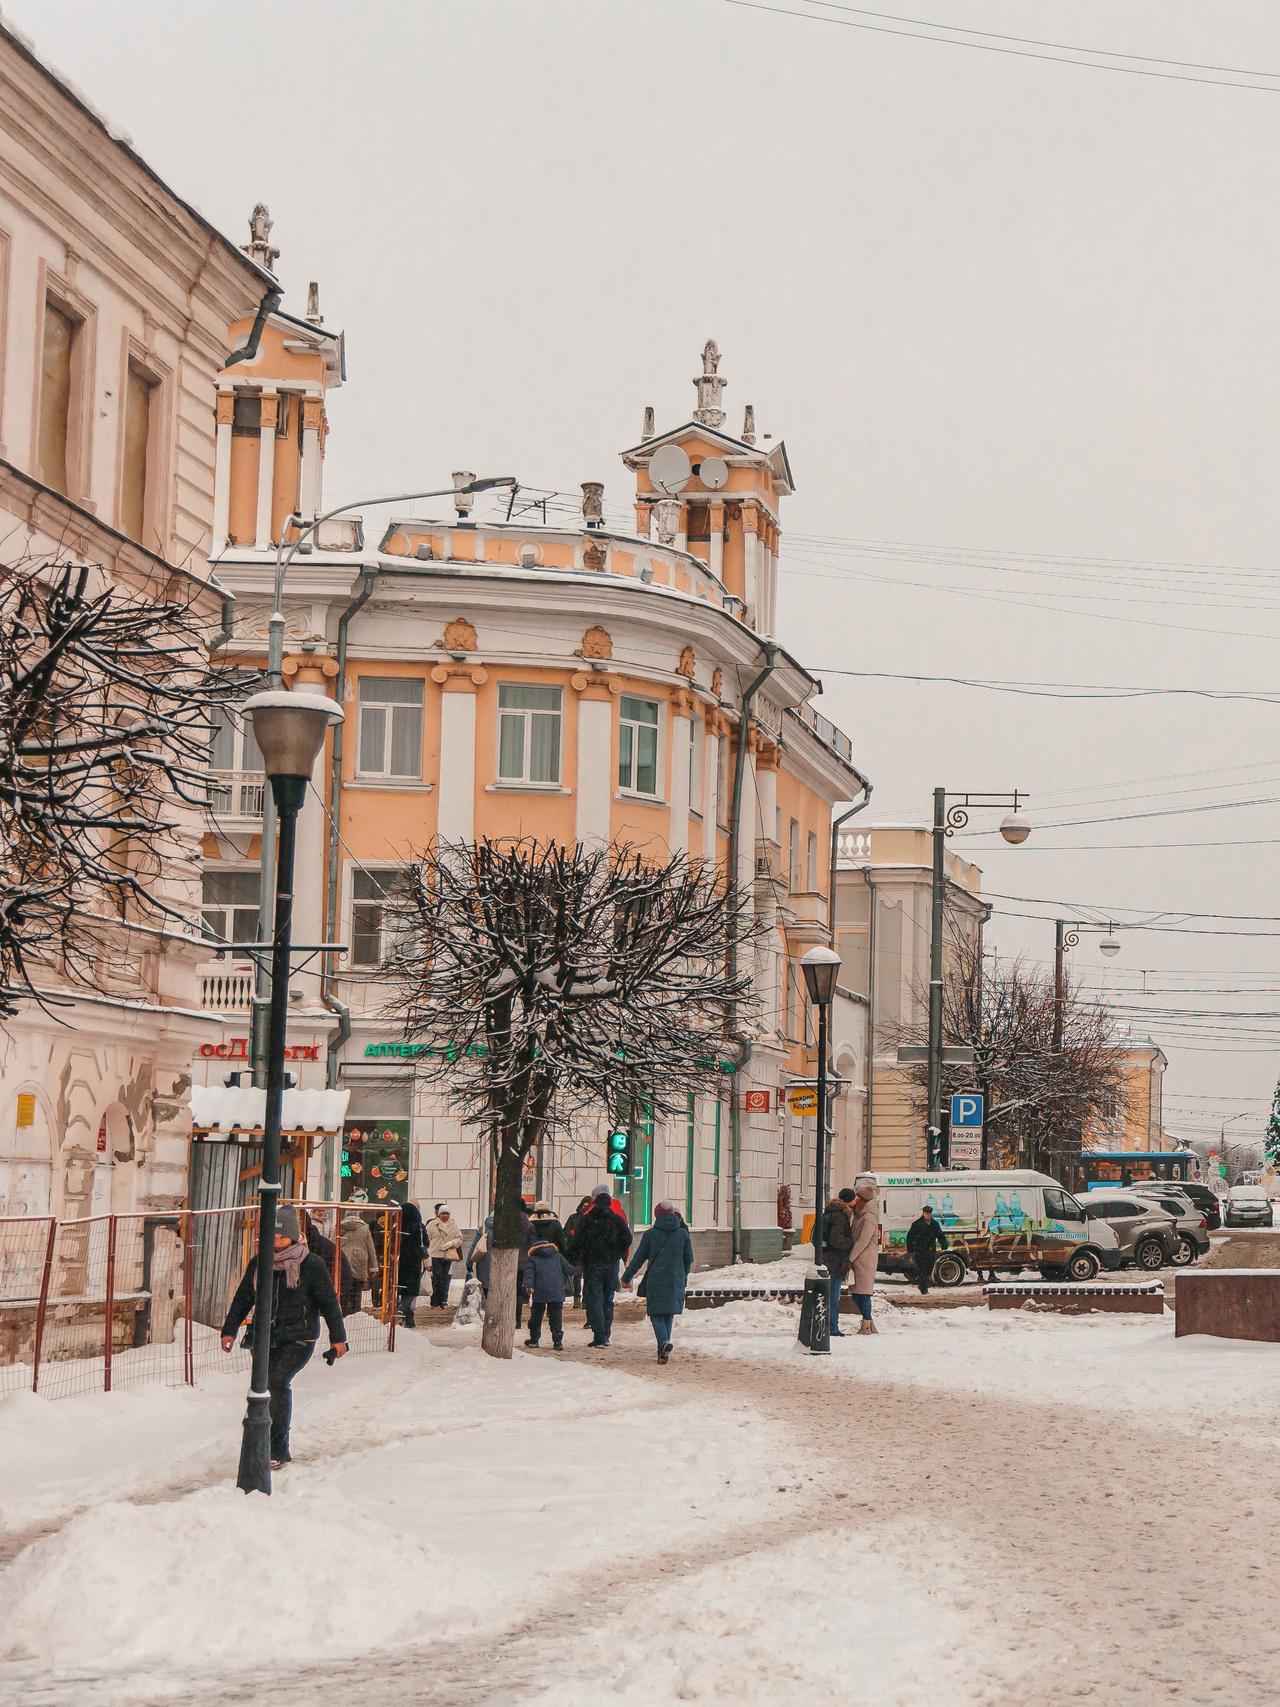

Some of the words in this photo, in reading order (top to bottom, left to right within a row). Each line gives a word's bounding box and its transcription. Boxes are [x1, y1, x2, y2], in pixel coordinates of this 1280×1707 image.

[959, 1099, 977, 1123] P
[616, 1135, 626, 1148] 19
[968, 1147, 977, 1155] 20
